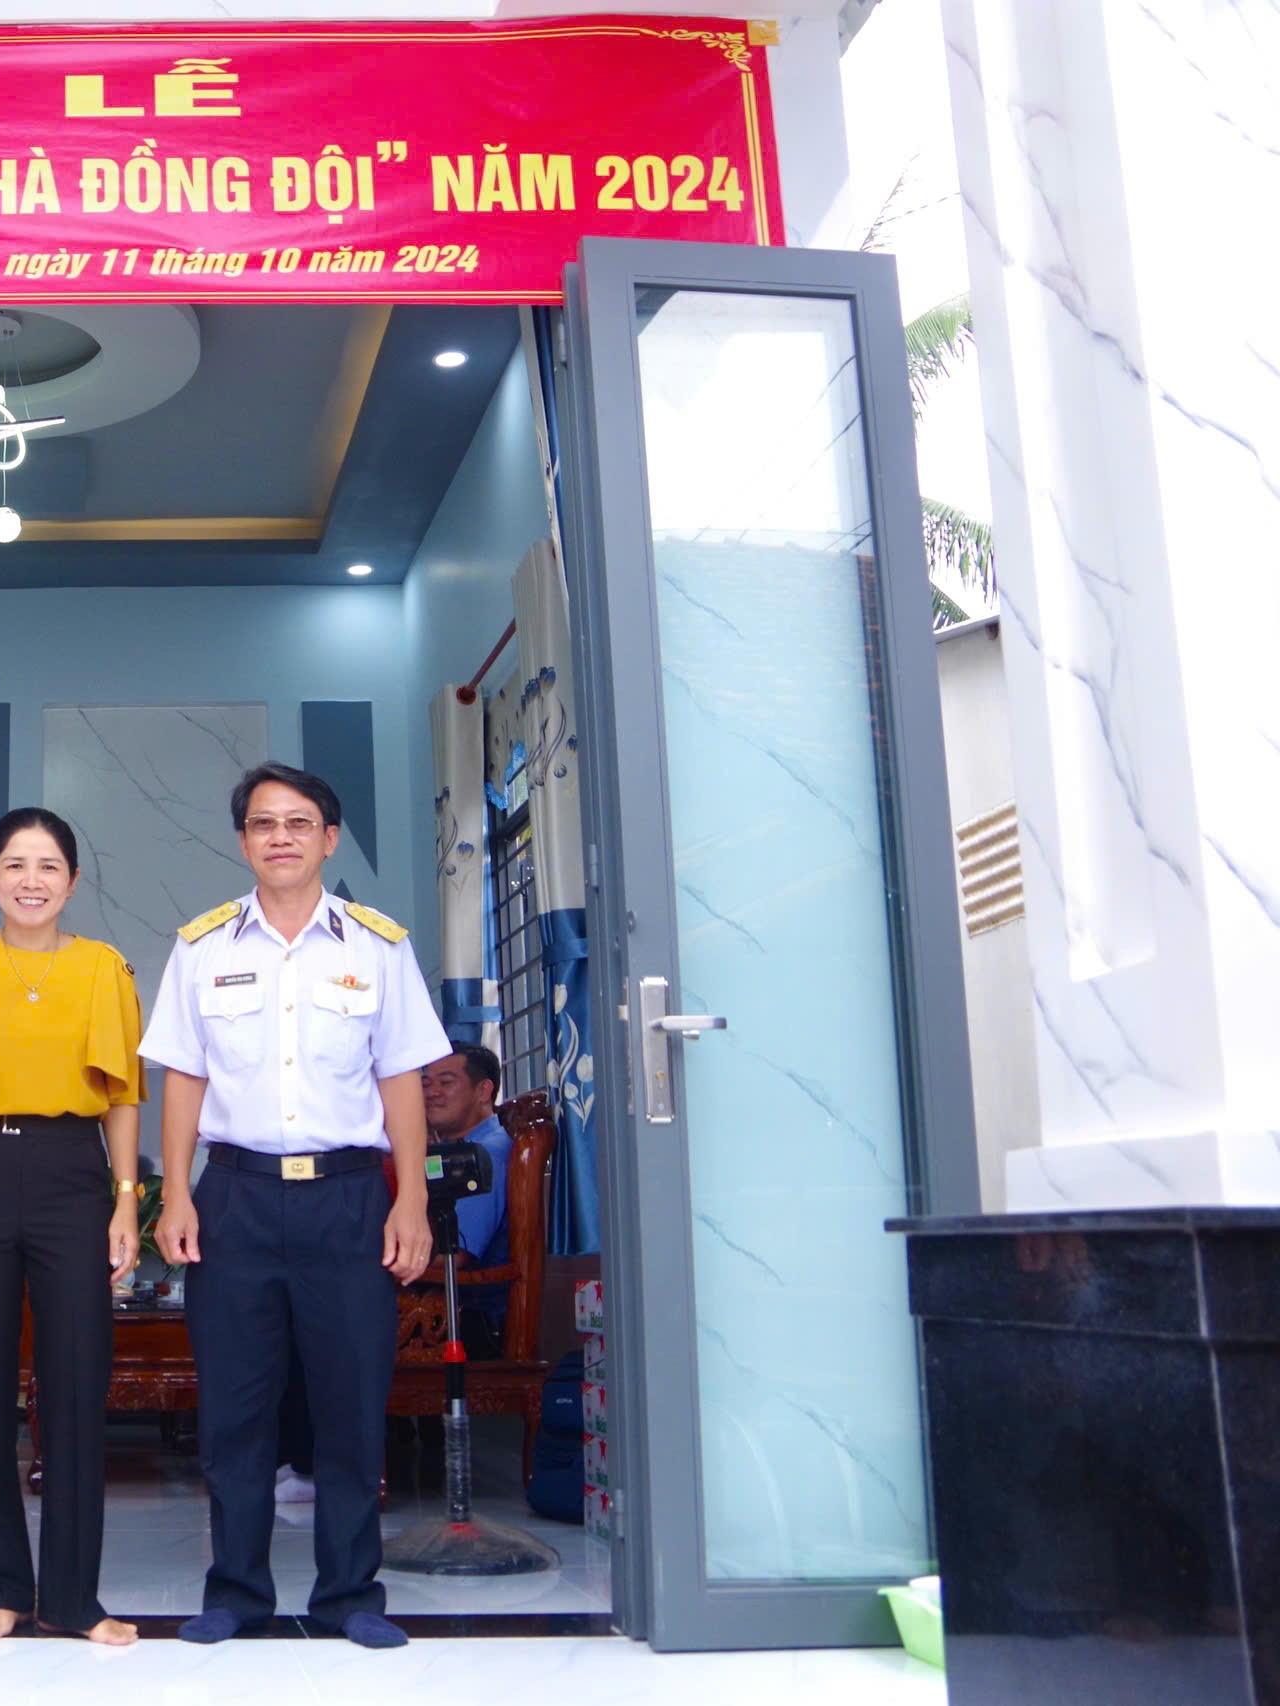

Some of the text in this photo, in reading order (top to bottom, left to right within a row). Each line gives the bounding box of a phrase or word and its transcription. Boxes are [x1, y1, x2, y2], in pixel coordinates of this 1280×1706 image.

[64, 57, 243, 118] LỄ
[79, 138, 252, 216] ĐỒNG
[269, 141, 408, 224] ĐỘI”
[430, 143, 577, 213] NĂM
[595, 154, 745, 213] 2024
[2, 248, 93, 281] ngày
[100, 248, 140, 276] 11
[150, 245, 246, 279] tháng
[260, 247, 304, 276] 10
[308, 244, 385, 275] năm
[394, 244, 480, 274] 2024
